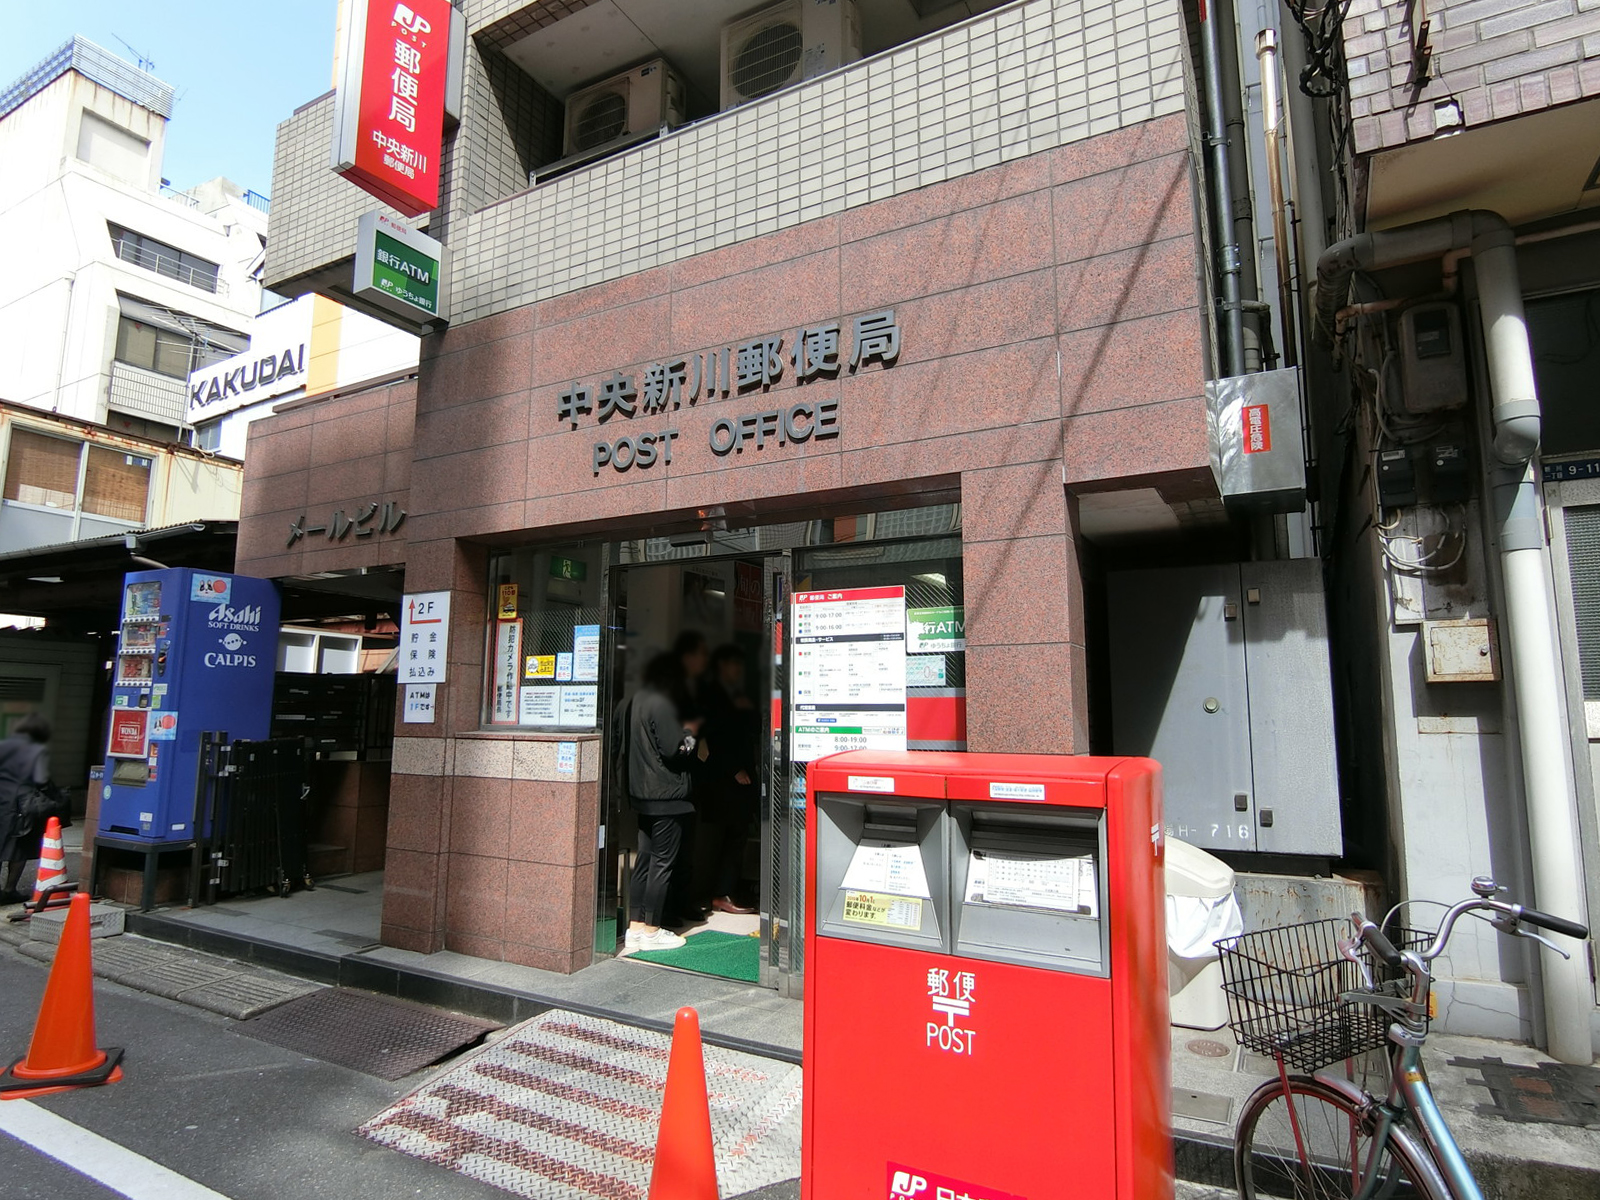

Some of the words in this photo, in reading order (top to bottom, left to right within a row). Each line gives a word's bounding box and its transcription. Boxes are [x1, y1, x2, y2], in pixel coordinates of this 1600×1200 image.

[393, 3, 432, 34] JP
[391, 20, 428, 48] POST
[388, 39, 422, 133] 郵便局
[372, 130, 428, 173] 中央新川
[383, 153, 416, 180] 郵便局
[377, 248, 431, 284] 銀行ATM
[396, 286, 433, 309] ゆうちょ銀行
[190, 343, 306, 409] KAKUDAI
[556, 309, 900, 430] 中央新川郵便局
[593, 428, 679, 477] POST
[709, 399, 840, 455] OFFICE
[286, 501, 407, 548] メールビル
[209, 603, 262, 625] Asahi
[418, 601, 435, 614] 2F
[208, 620, 228, 630] SOFT
[229, 623, 260, 632] DRINKS
[411, 631, 437, 644] 貯金
[204, 652, 256, 668] CALPIS
[410, 649, 437, 660] 保険
[409, 667, 435, 678] 払込み
[504, 625, 517, 719] 防犯カメラ作動中です
[409, 691, 431, 699] ATMは
[1211, 823, 1249, 839] 716
[846, 901, 885, 912] 郵便料金などが
[927, 967, 976, 1002] 郵便
[927, 1022, 976, 1055] POST
[892, 1171, 928, 1196] JP
